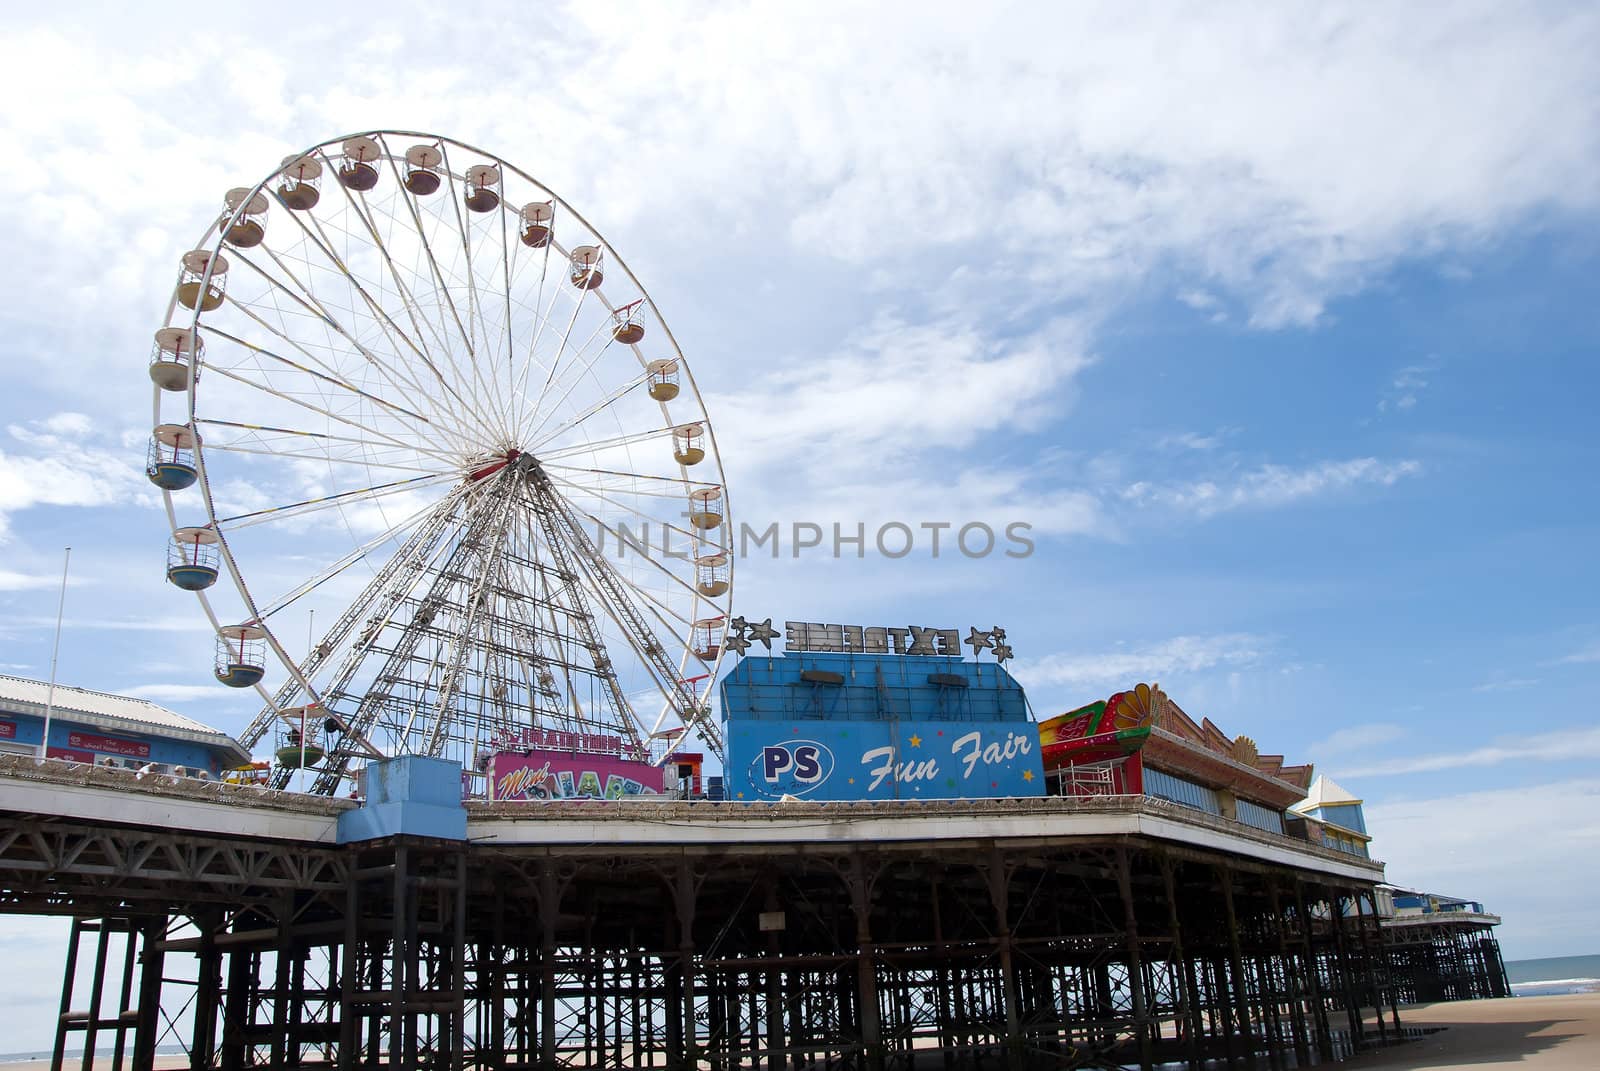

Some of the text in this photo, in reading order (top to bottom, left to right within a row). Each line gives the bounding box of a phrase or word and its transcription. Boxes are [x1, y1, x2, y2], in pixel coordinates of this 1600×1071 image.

[498, 761, 551, 801] Mini
[763, 745, 823, 783] PS
[861, 731, 1031, 792] Fun Fair
